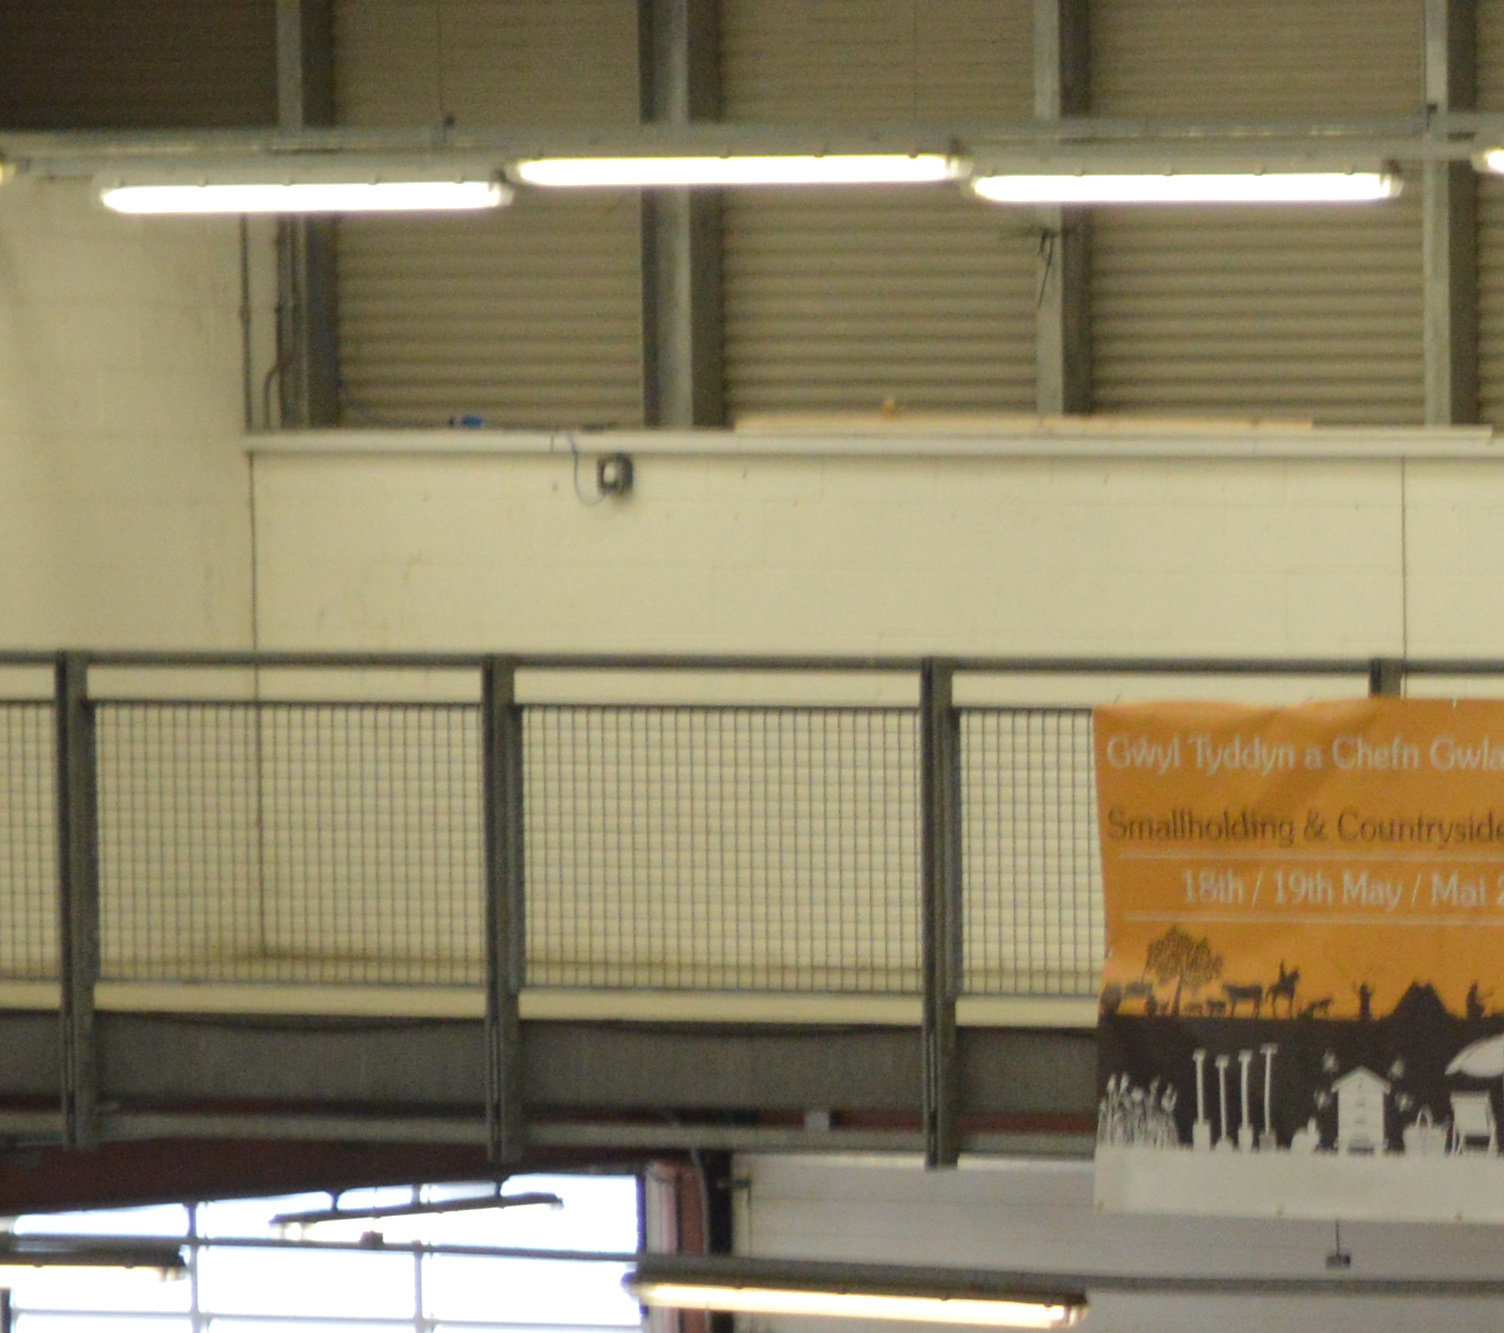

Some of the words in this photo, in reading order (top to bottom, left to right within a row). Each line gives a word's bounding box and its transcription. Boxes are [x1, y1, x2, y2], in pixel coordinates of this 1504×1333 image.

[1189, 733, 1294, 776] Tyddyn
[1305, 743, 1322, 769] a
[1332, 735, 1419, 770] Chefn
[1108, 805, 1294, 848] Smallholding
[1304, 809, 1327, 841] &
[1183, 868, 1244, 903] 18th
[1275, 868, 1333, 904] 19th
[1342, 870, 1402, 912] May
[1432, 871, 1486, 906] Mai
